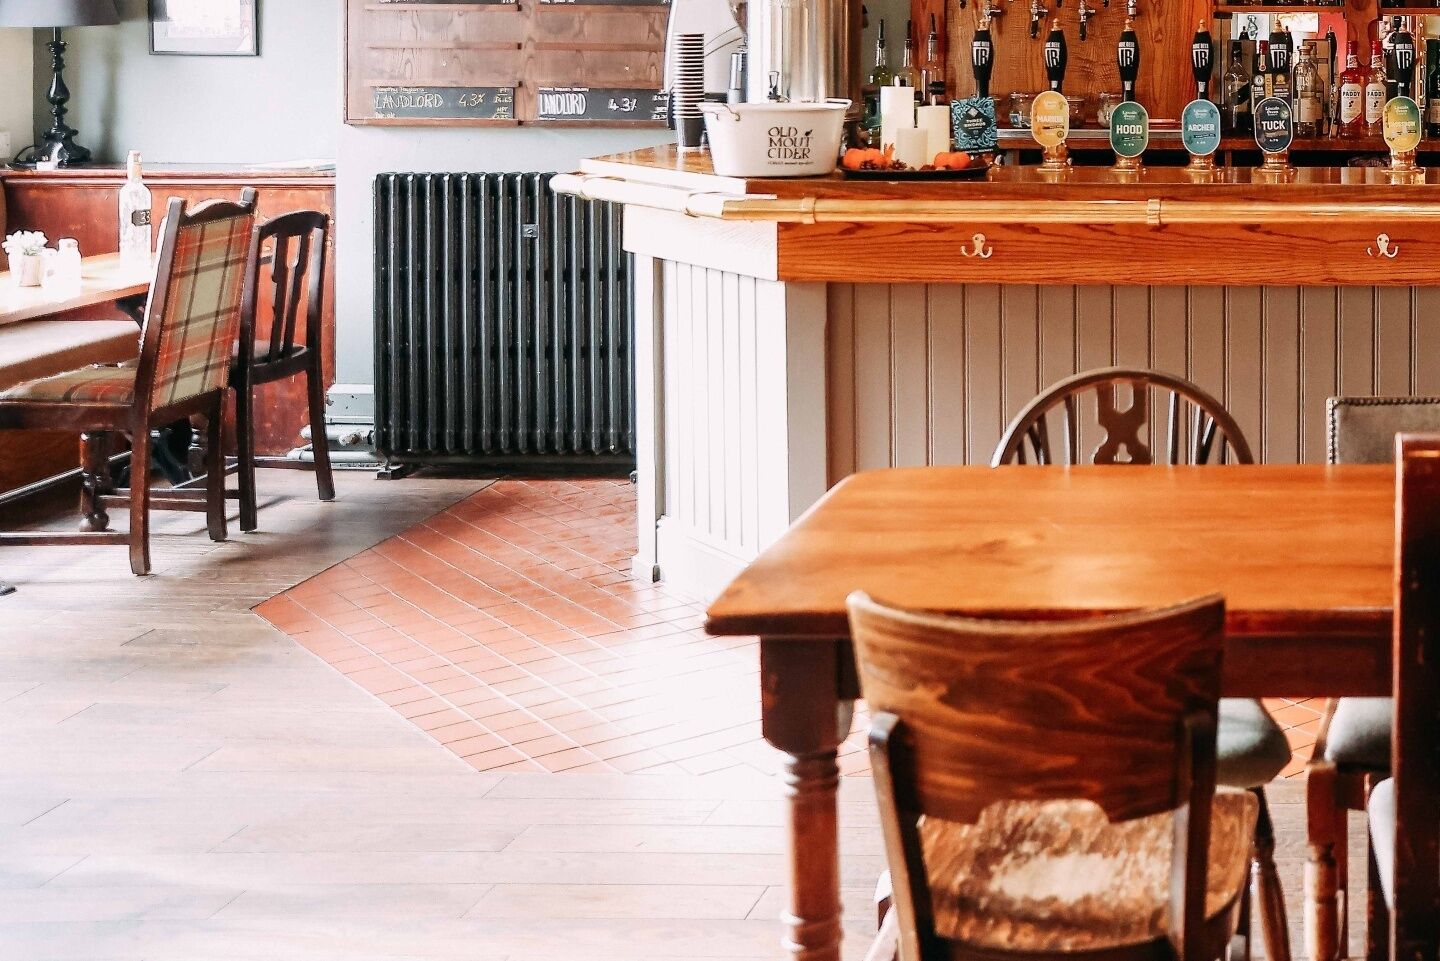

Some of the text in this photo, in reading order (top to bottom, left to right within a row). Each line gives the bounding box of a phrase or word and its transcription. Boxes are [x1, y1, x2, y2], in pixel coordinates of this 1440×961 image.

[374, 93, 444, 109] LANDLORD
[539, 93, 586, 115] LANDLORD
[1116, 124, 1143, 134] HOOD
[1187, 123, 1215, 132] ARCHER
[1261, 120, 1286, 131] TUCK
[767, 126, 798, 138] OLD
[767, 136, 814, 148] MOUT
[767, 147, 811, 160] CIDER
